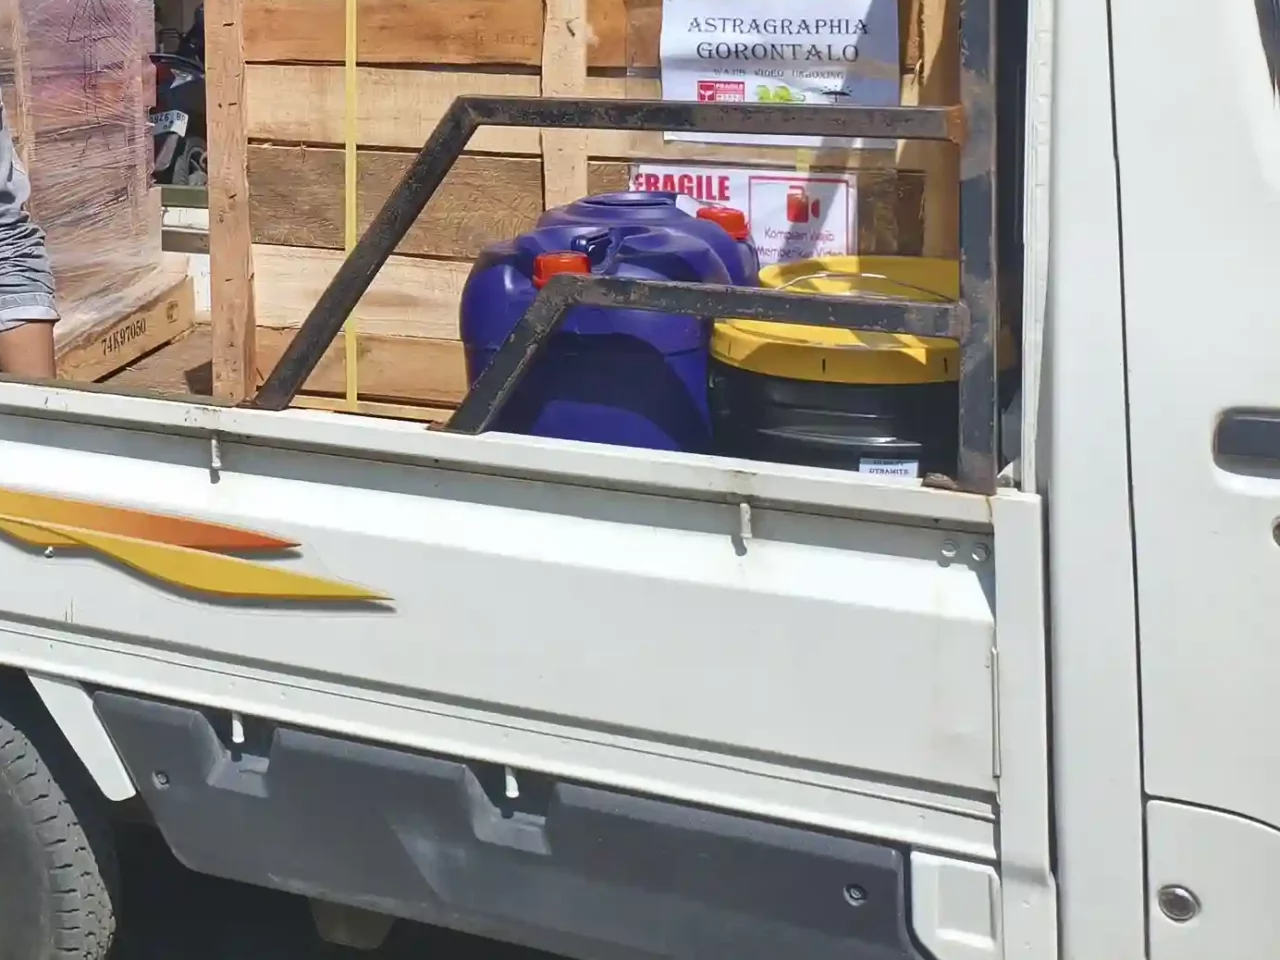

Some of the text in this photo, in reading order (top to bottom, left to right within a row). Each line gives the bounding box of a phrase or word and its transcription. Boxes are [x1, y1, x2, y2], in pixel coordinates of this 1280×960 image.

[687, 16, 870, 36] ASTRAGRAPHIA
[696, 41, 859, 63] GORONTALO
[754, 68, 784, 78] VIDEO
[101, 318, 147, 356] 74K97050
